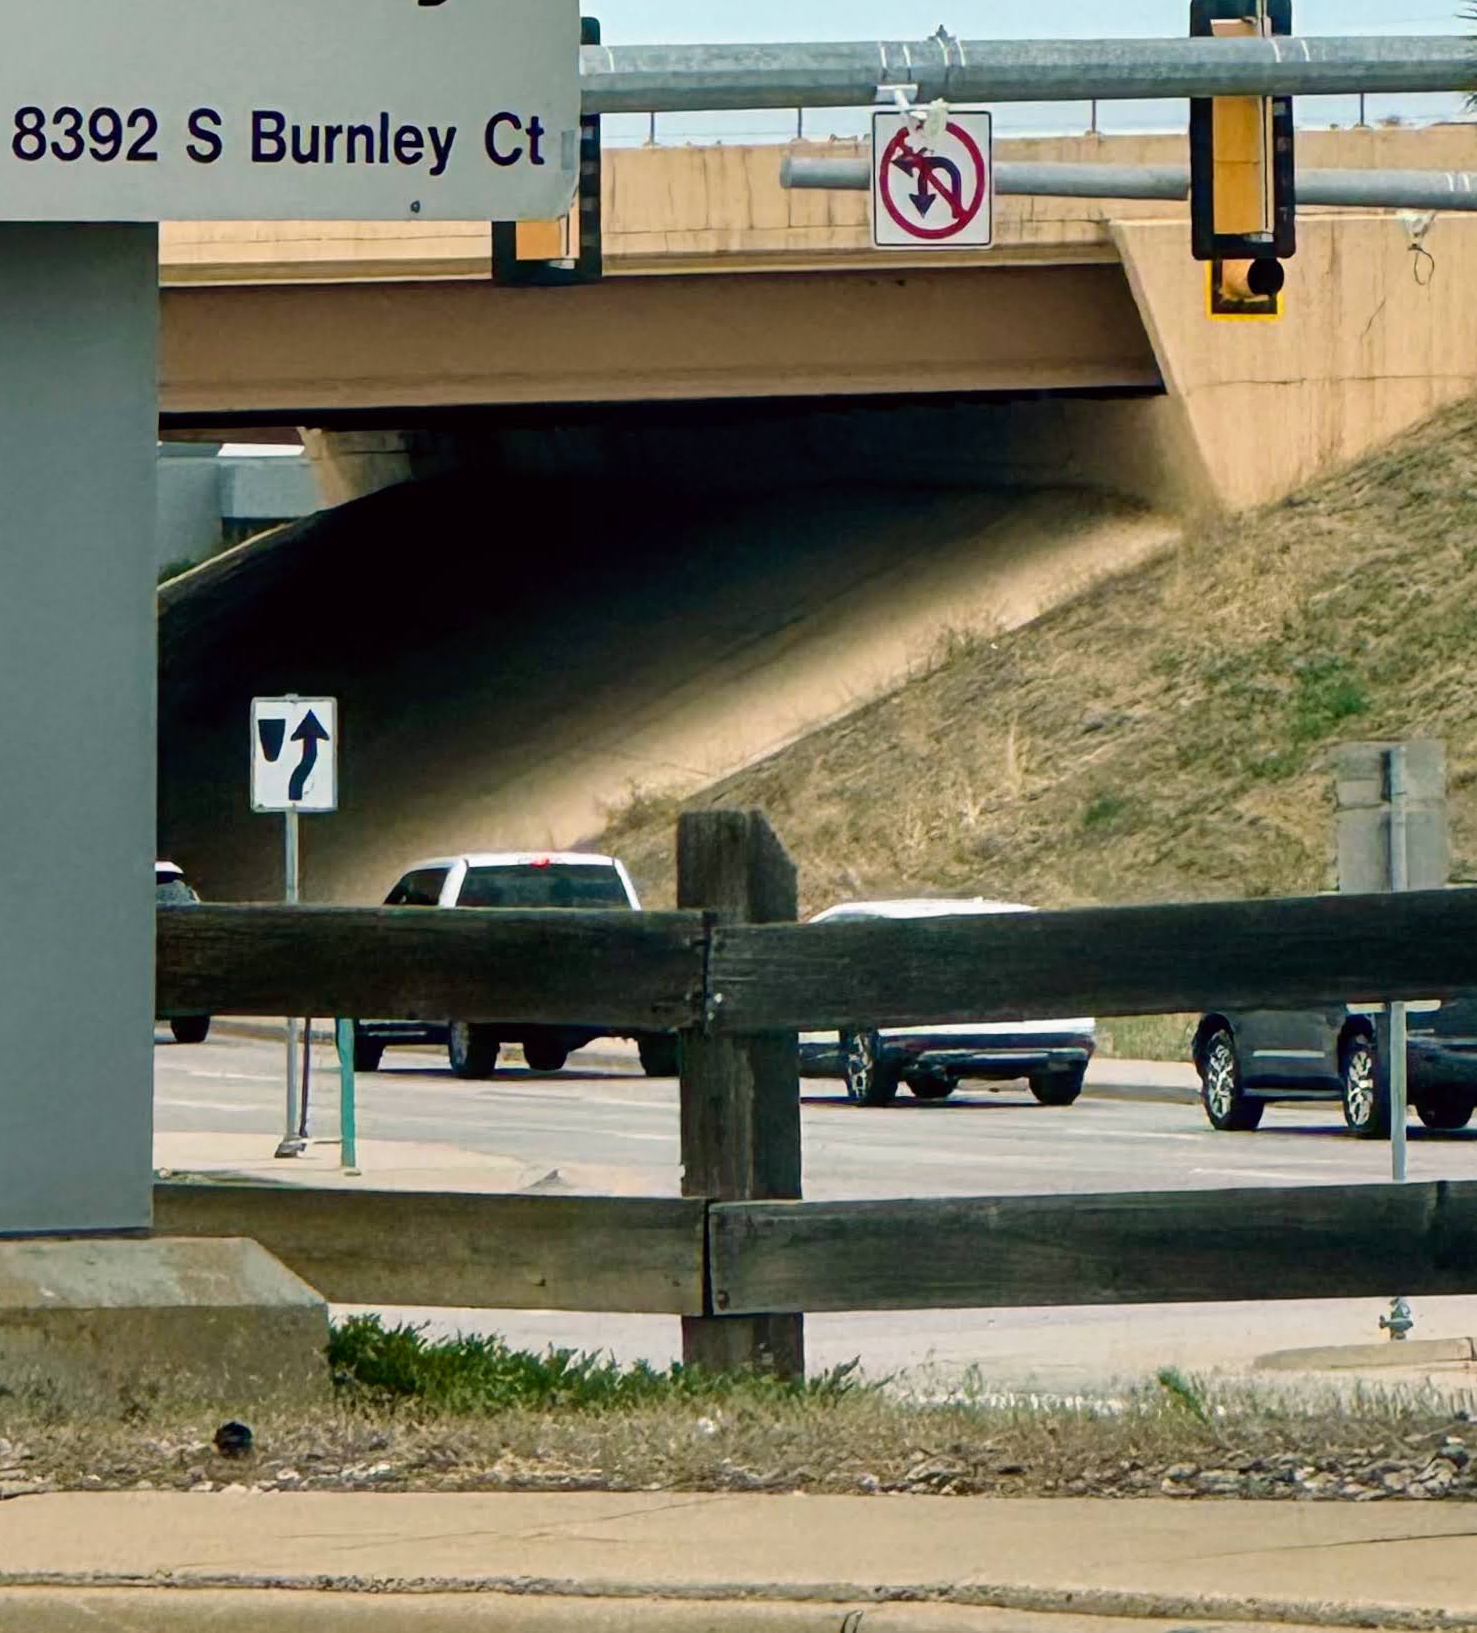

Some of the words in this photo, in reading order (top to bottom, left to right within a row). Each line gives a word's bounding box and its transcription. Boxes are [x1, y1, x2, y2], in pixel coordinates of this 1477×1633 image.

[11, 106, 158, 163] 8392
[186, 107, 223, 164] S
[251, 110, 458, 177] Burnley
[484, 111, 546, 167] Ct
